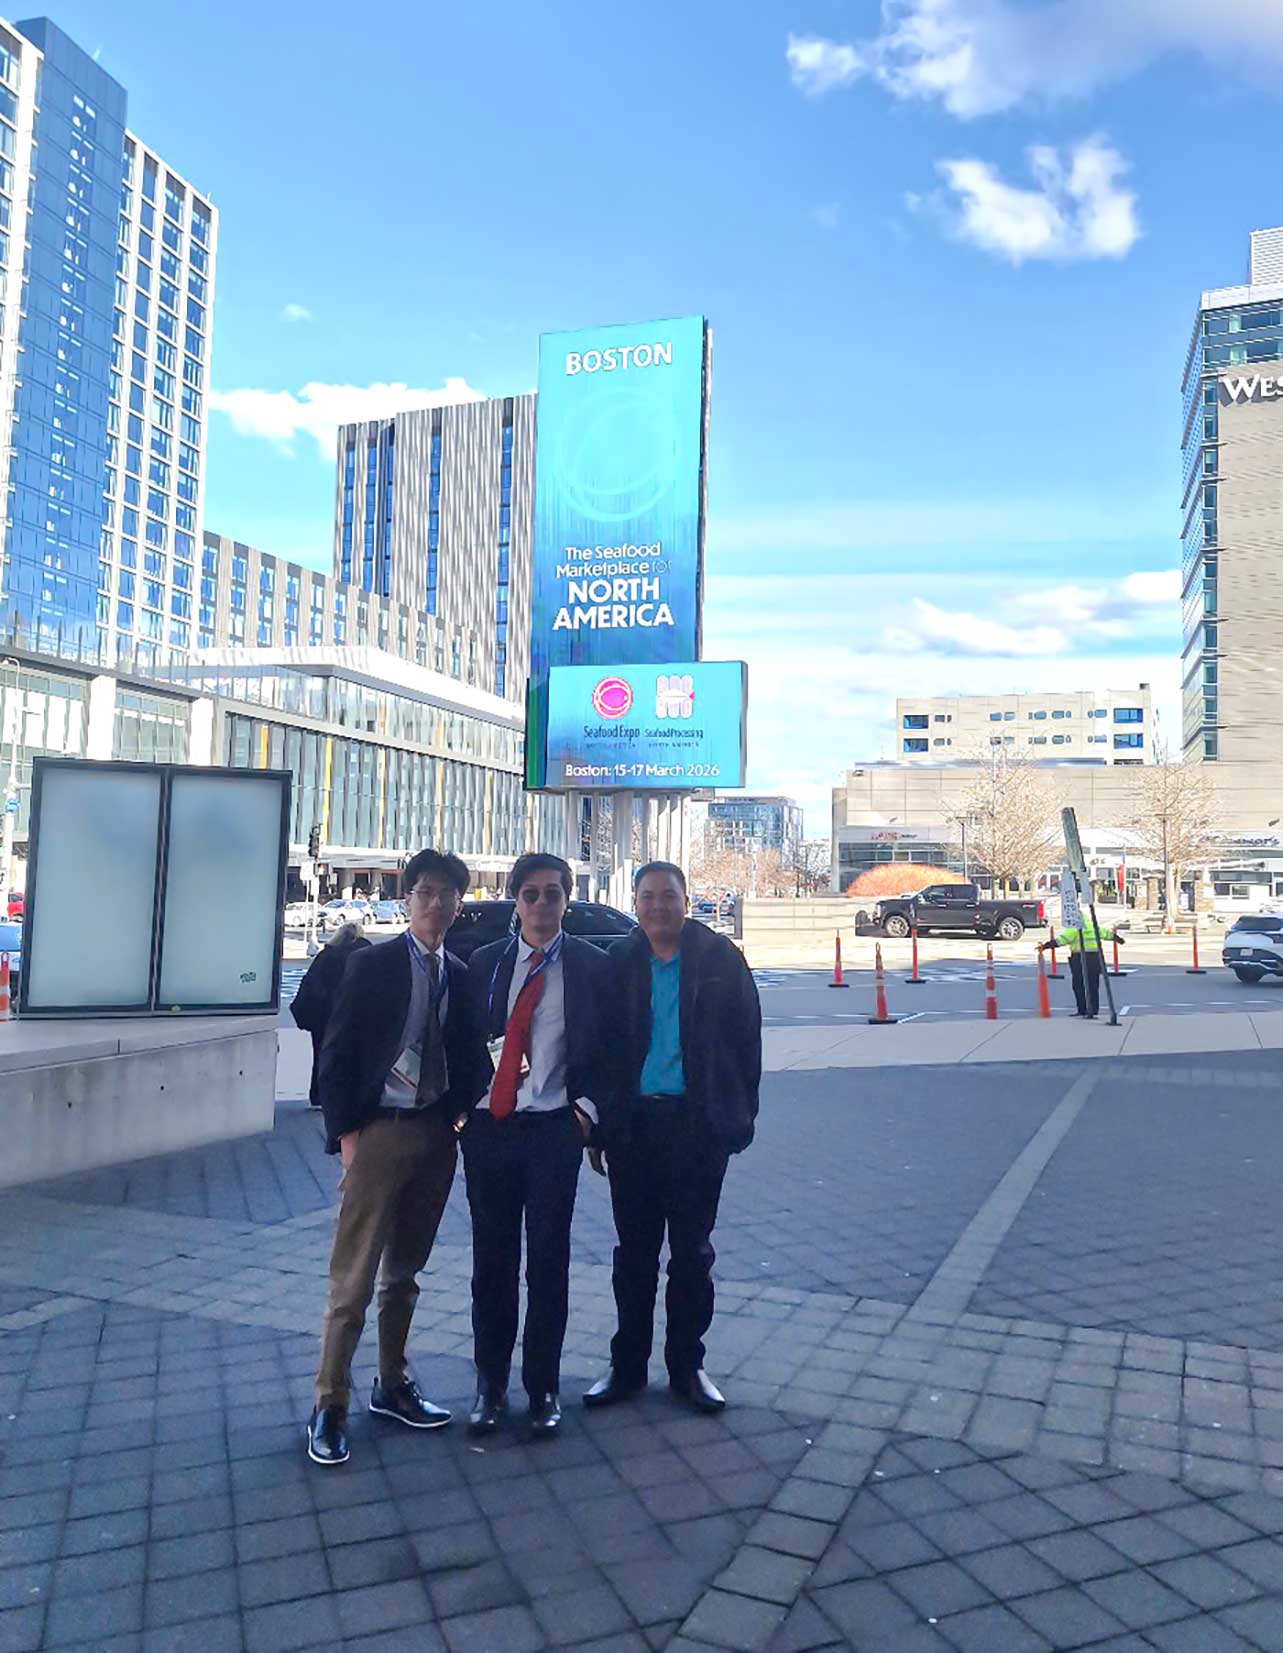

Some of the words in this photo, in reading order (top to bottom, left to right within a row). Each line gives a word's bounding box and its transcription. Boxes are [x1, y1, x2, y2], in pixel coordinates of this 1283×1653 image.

[566, 342, 672, 375] BOSTON
[565, 547, 593, 560] The
[595, 541, 661, 559] Seafood
[556, 560, 650, 579] Marketplace
[568, 576, 660, 604] NORTH
[552, 602, 675, 631] AMERICA
[584, 725, 618, 738] Seafood
[619, 724, 640, 742] Expo
[565, 764, 612, 777] Boston:
[614, 764, 643, 776] 15-17
[645, 764, 684, 776] March
[687, 764, 720, 776] 2026
